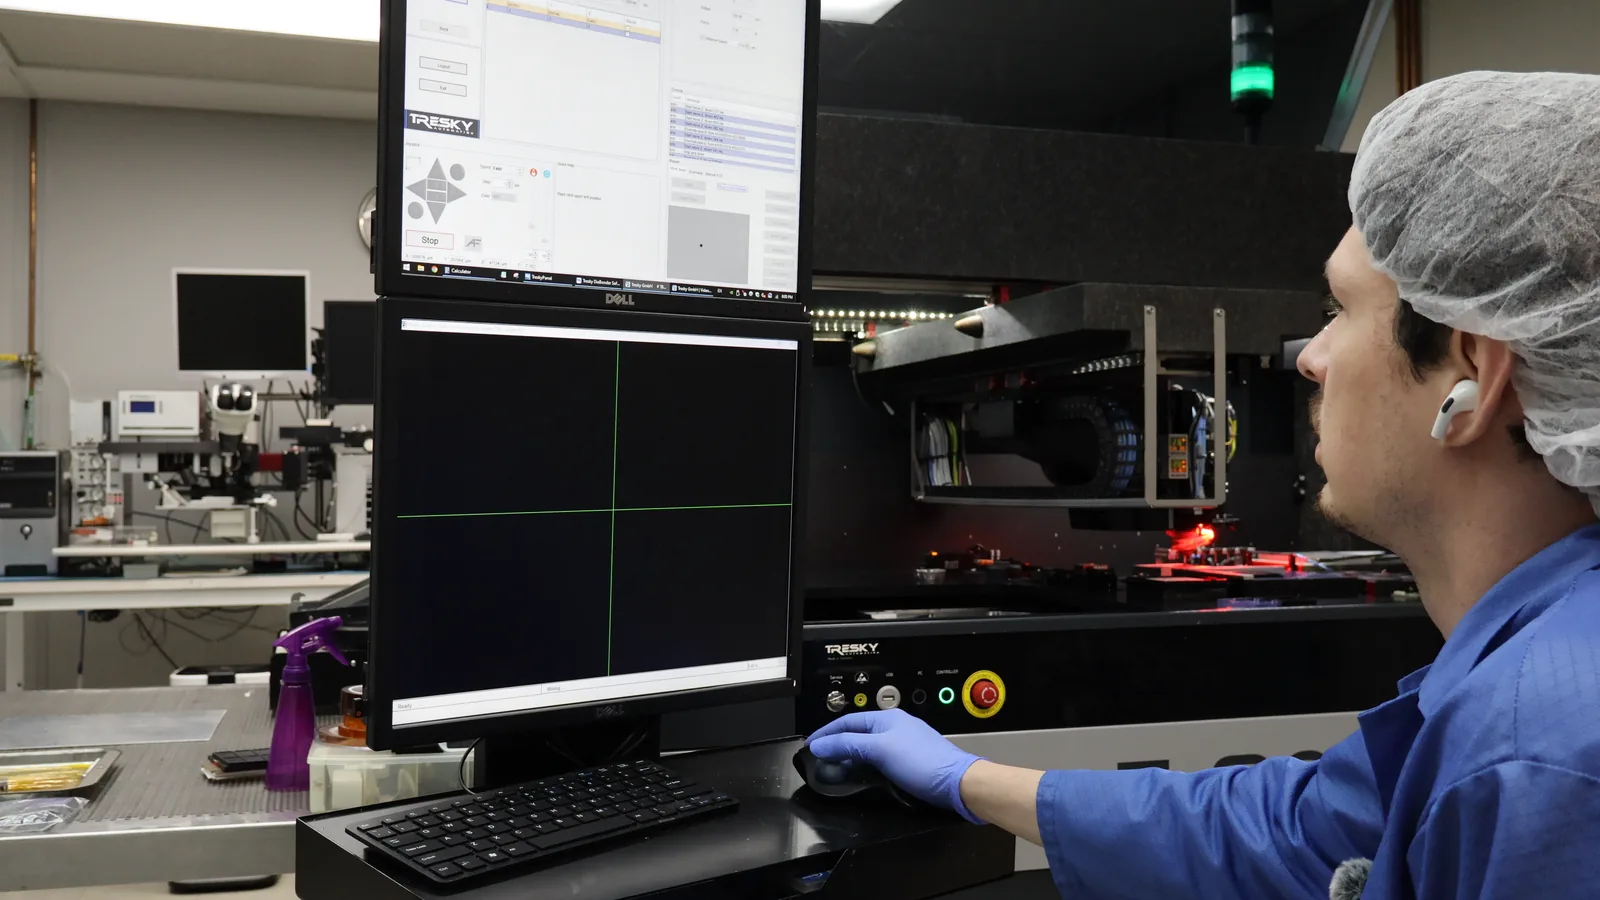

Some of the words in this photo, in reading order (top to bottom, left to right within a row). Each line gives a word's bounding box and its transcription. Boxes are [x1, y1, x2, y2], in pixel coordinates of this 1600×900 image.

[409, 112, 474, 131] TRESKY
[433, 127, 474, 135] AUTOMATION
[421, 236, 439, 246] Stop
[465, 238, 482, 247] AF
[605, 293, 635, 306] DELL
[825, 643, 879, 655] TRESKY
[596, 704, 625, 718] DELL
